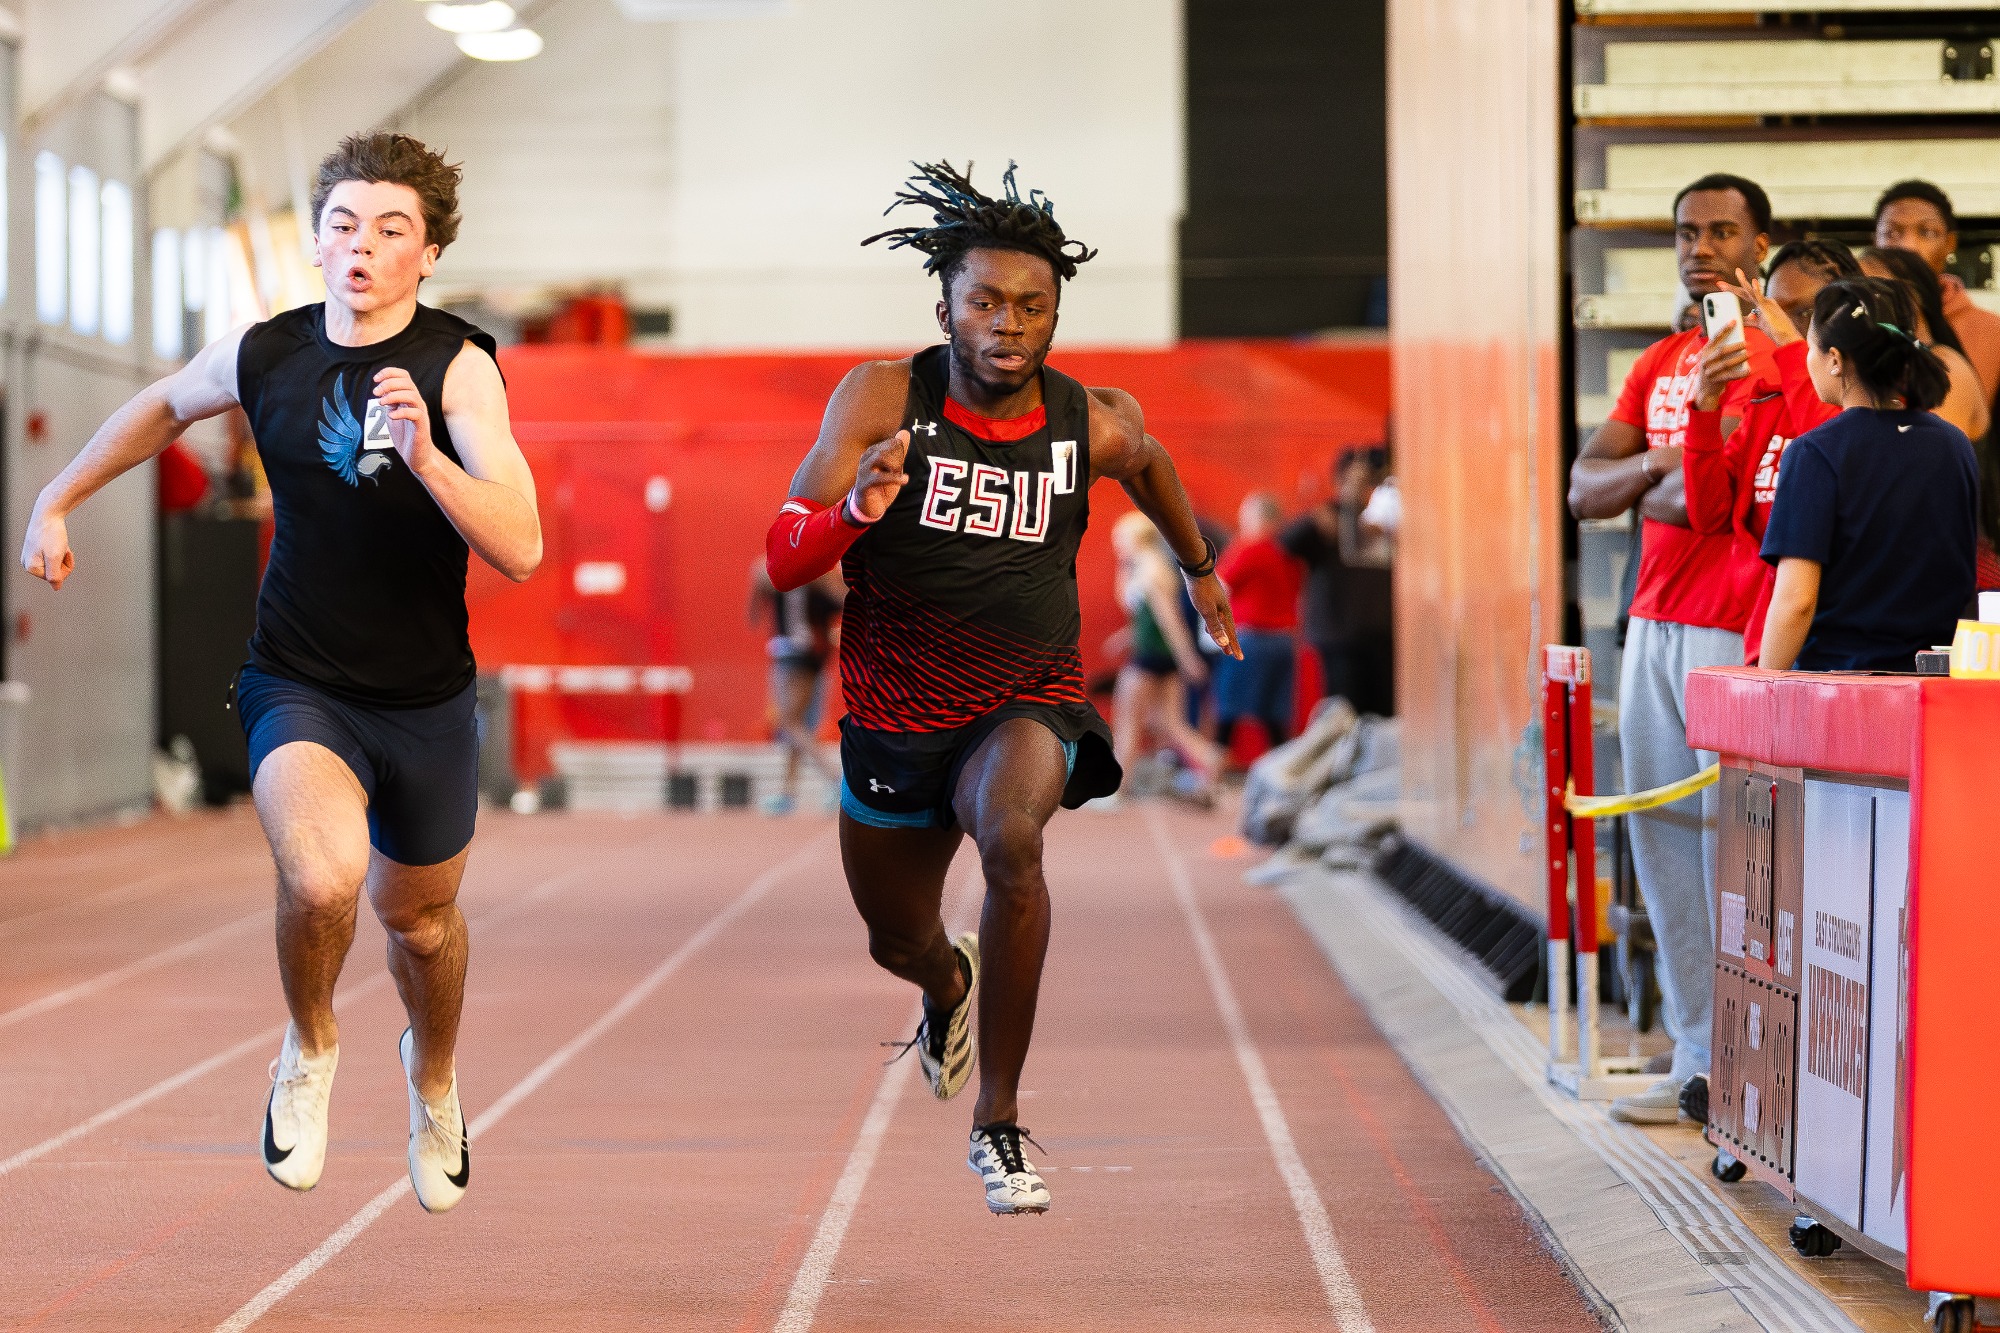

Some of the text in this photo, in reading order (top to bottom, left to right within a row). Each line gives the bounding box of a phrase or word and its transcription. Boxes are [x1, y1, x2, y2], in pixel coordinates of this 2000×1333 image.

[368, 405, 391, 440] 2
[919, 455, 1055, 543] ESU
[1815, 910, 1828, 950] EAST
[1807, 962, 1866, 1100] WARRIORS
